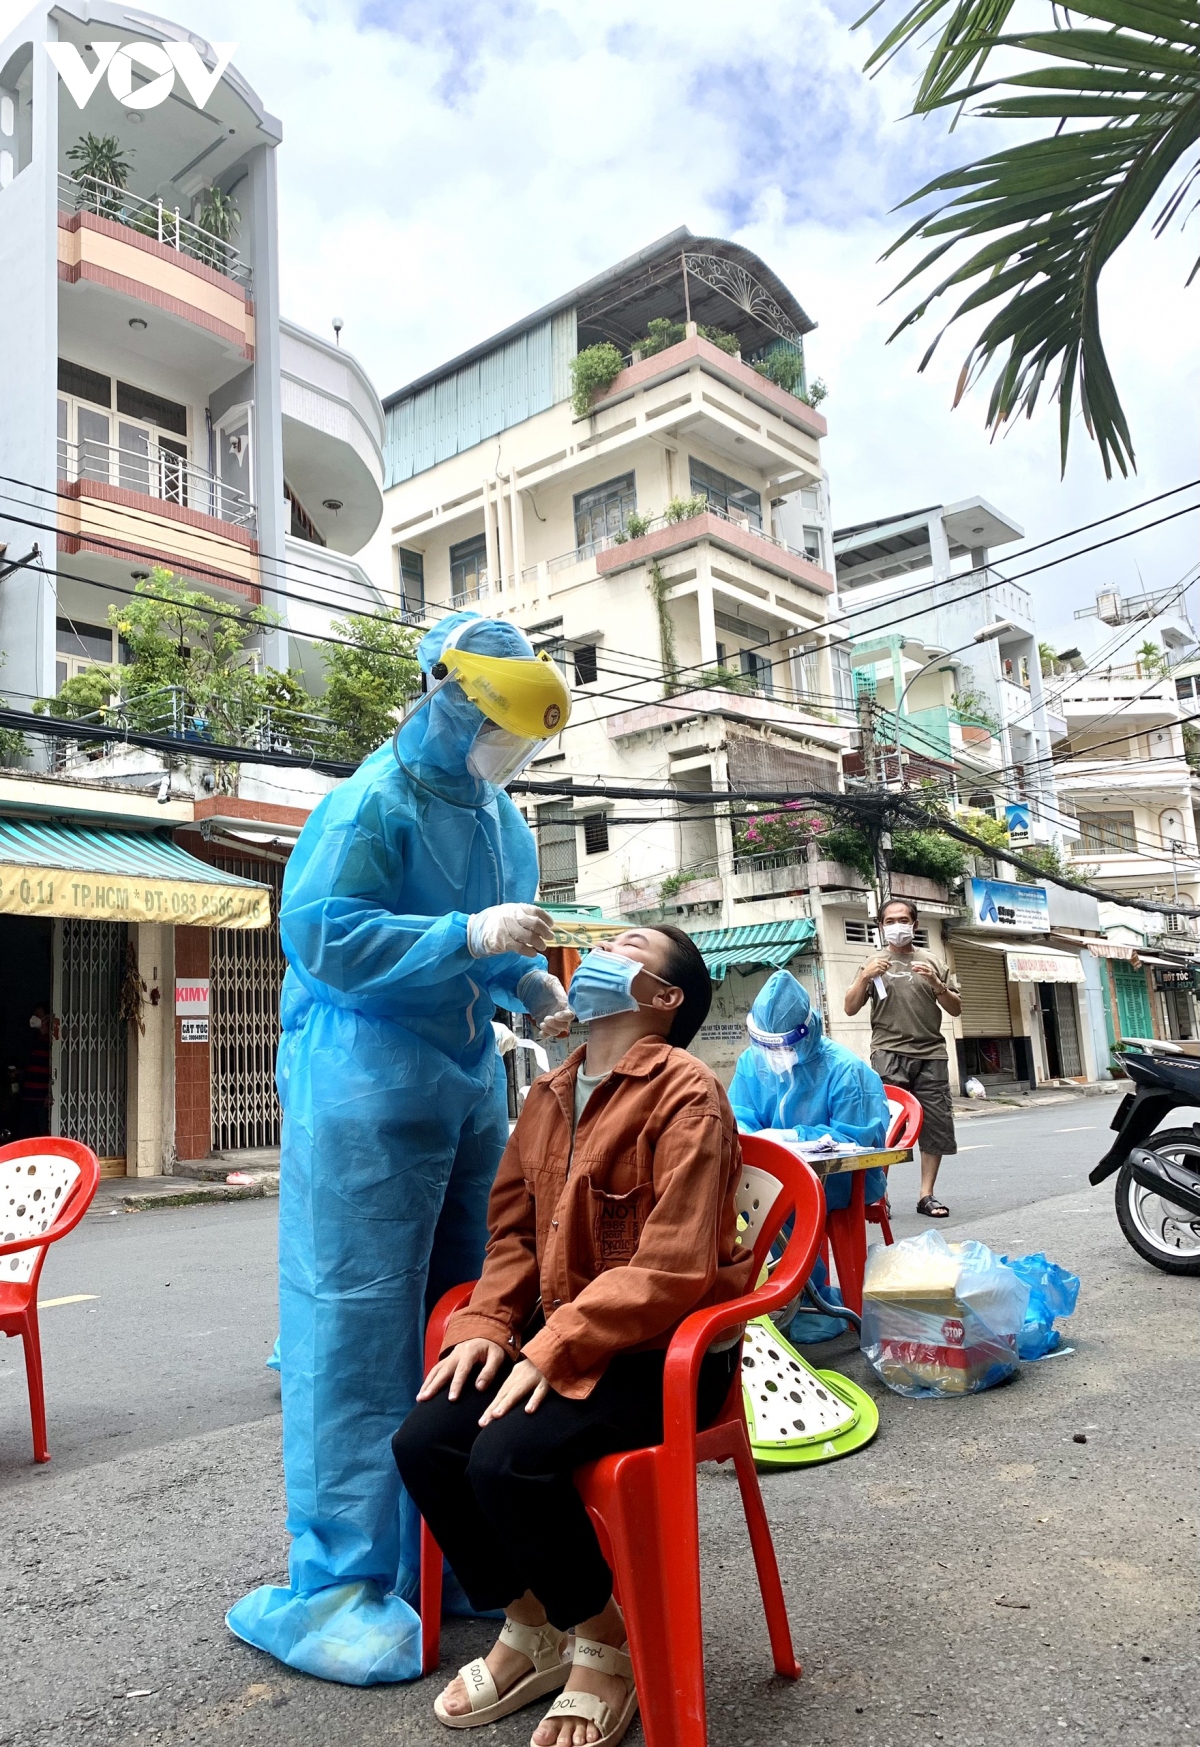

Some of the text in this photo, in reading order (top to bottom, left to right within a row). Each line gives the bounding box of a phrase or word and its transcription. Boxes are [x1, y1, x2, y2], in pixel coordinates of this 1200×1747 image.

[20, 878, 54, 905] Q.11
[72, 883, 129, 911] TP.HCM
[144, 889, 169, 913] ĐT:
[1176, 970, 1188, 981] TÓC
[182, 1020, 208, 1033] CẮT TÓC
[1153, 1058, 1200, 1070] VISION
[945, 1327, 963, 1338] STOP
